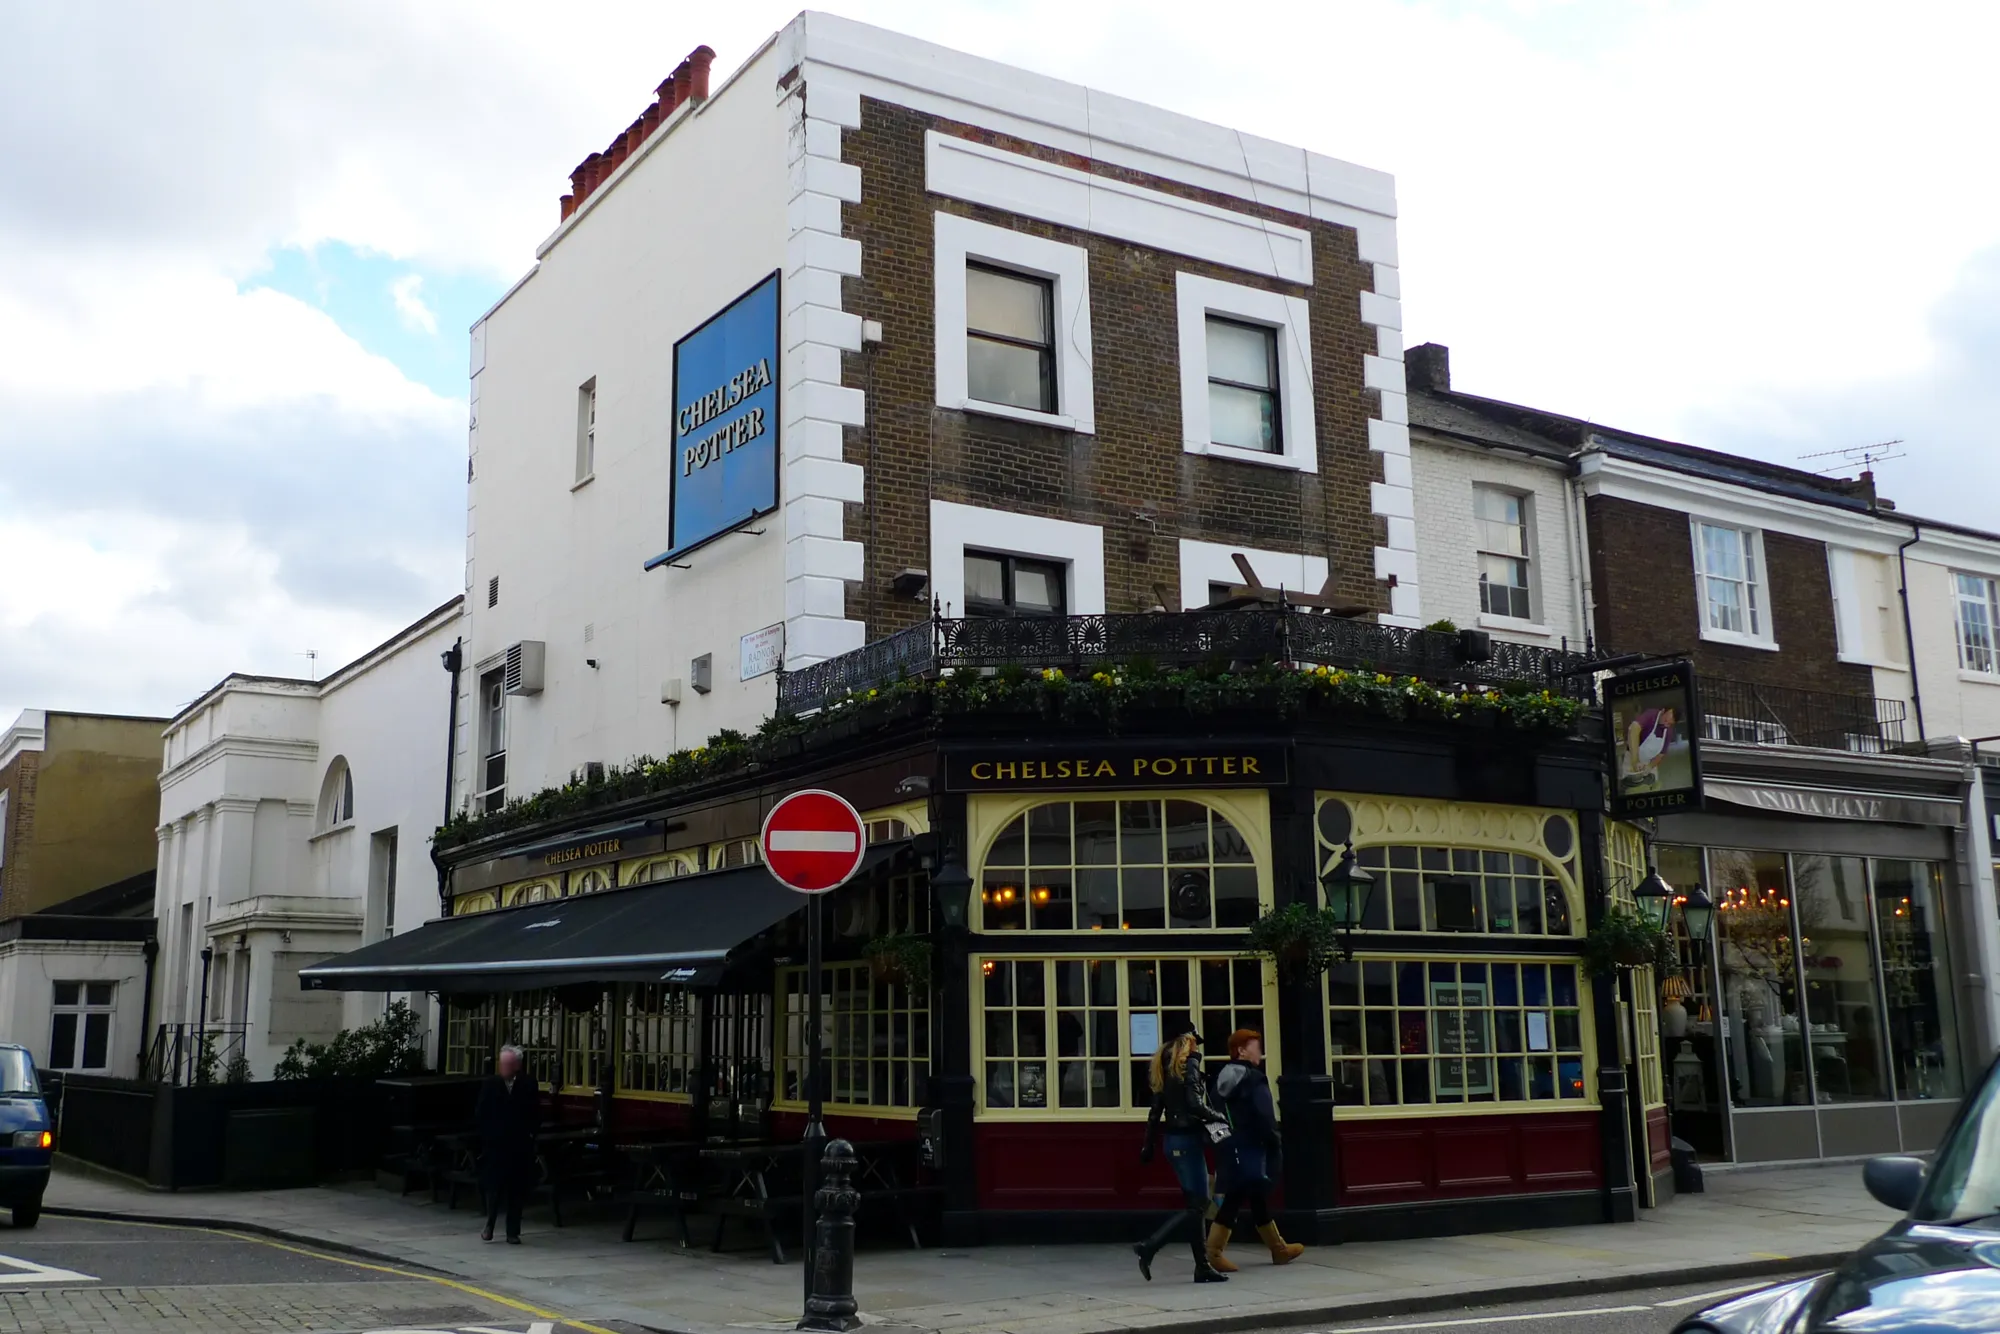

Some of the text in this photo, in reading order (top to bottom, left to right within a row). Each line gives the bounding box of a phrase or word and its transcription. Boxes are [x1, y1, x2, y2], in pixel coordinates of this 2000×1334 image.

[677, 358, 772, 437] CHELSEA
[683, 407, 765, 477] POTTER
[748, 645, 775, 664] RADNOR
[743, 661, 761, 678] WALK
[1614, 674, 1681, 695] CHELSEA
[970, 756, 1261, 780] CHELSEA POTTER
[1626, 793, 1686, 810] POTTER
[1750, 789, 1882, 818] INDIA JANE
[544, 839, 620, 866] CHELSEA POTTER
